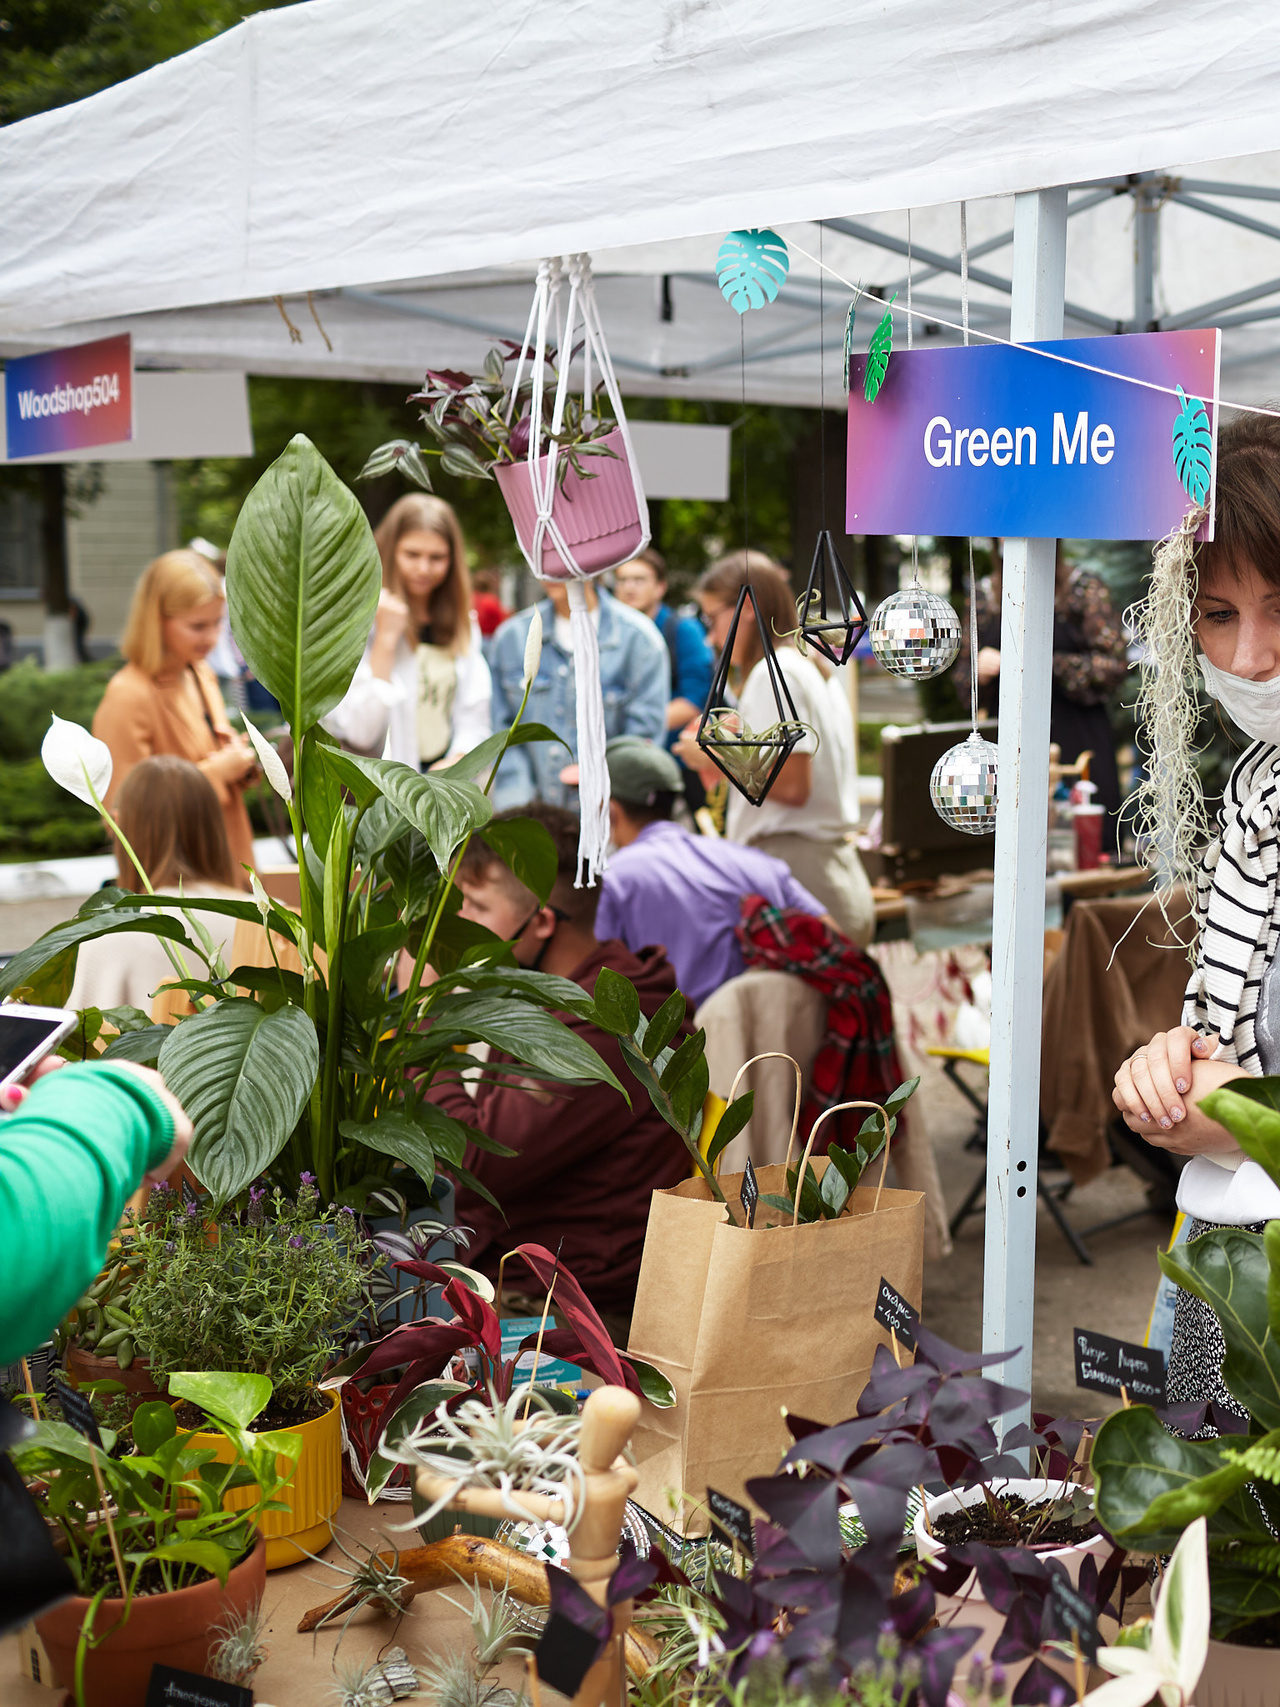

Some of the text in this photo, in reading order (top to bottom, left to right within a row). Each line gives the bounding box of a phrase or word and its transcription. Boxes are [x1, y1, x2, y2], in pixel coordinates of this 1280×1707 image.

[18, 372, 120, 420] Woodshop504
[923, 411, 1116, 468] Green Me
